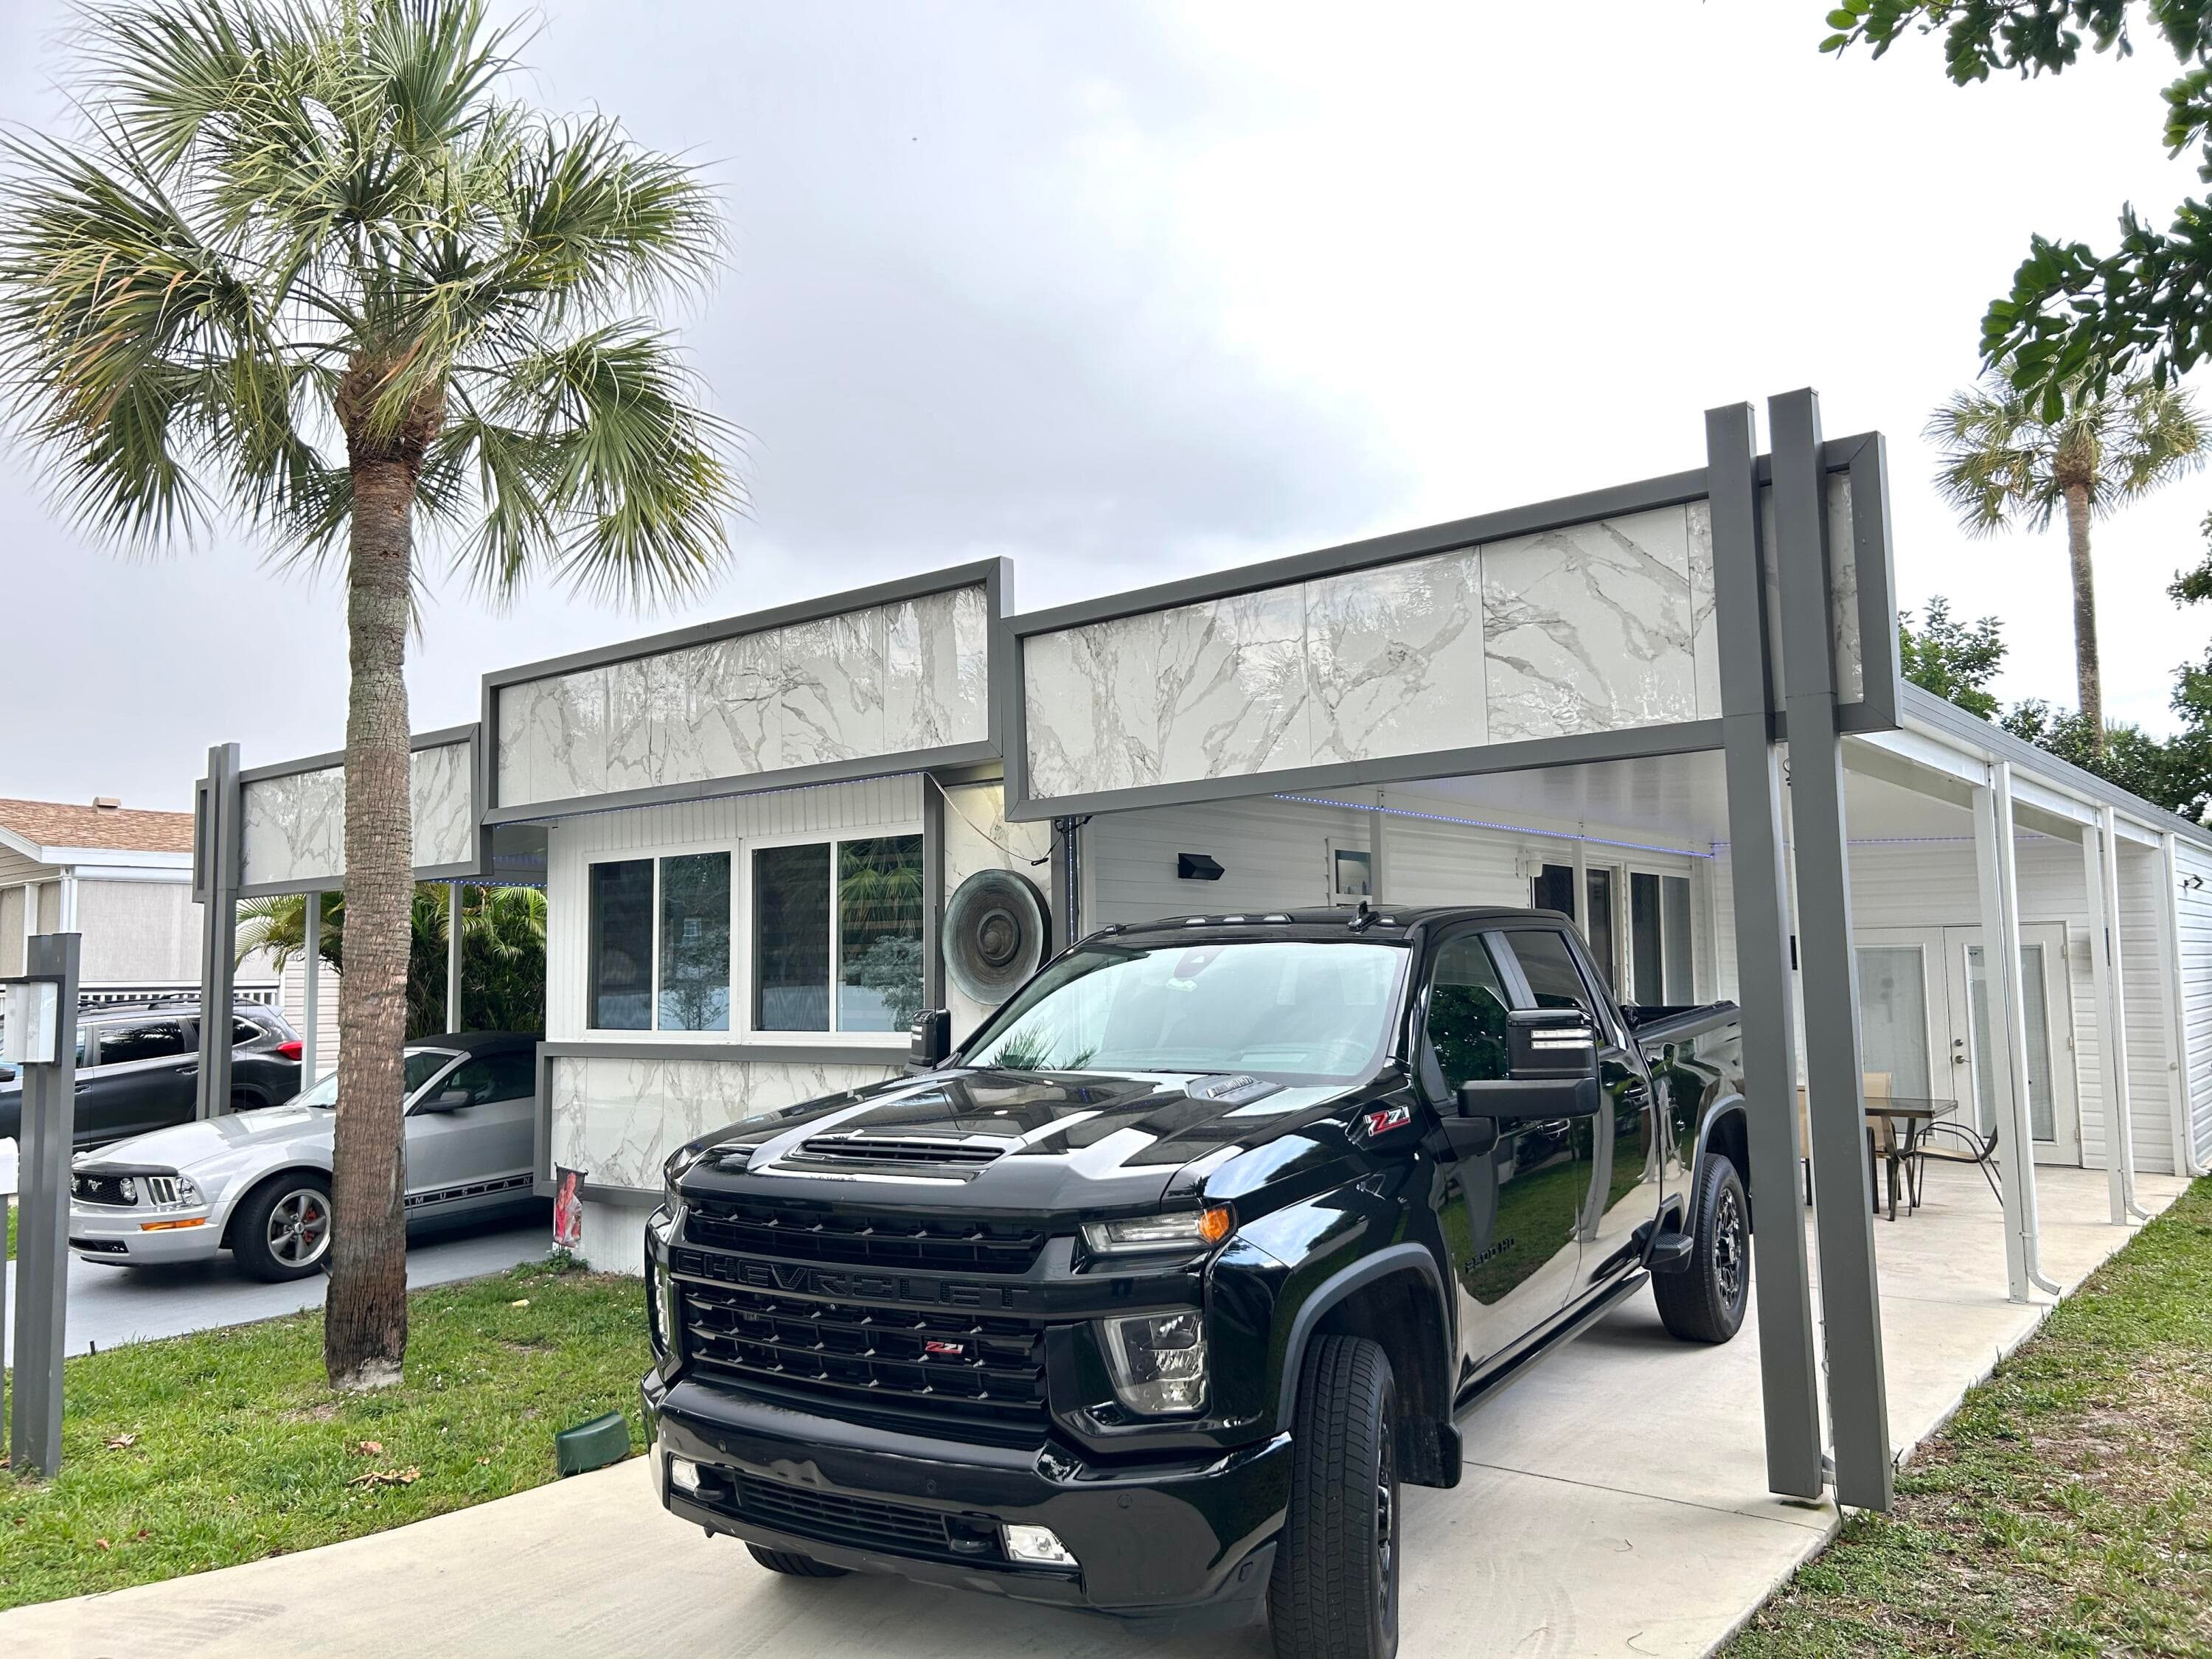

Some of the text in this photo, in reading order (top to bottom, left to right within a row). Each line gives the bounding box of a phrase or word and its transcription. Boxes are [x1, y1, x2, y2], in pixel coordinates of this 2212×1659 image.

[1363, 1105, 1410, 1136] Z71
[415, 1177, 531, 1205] MUSTAN
[676, 1249, 1029, 1309] CHEVROLET
[925, 1340, 964, 1354] Z71
